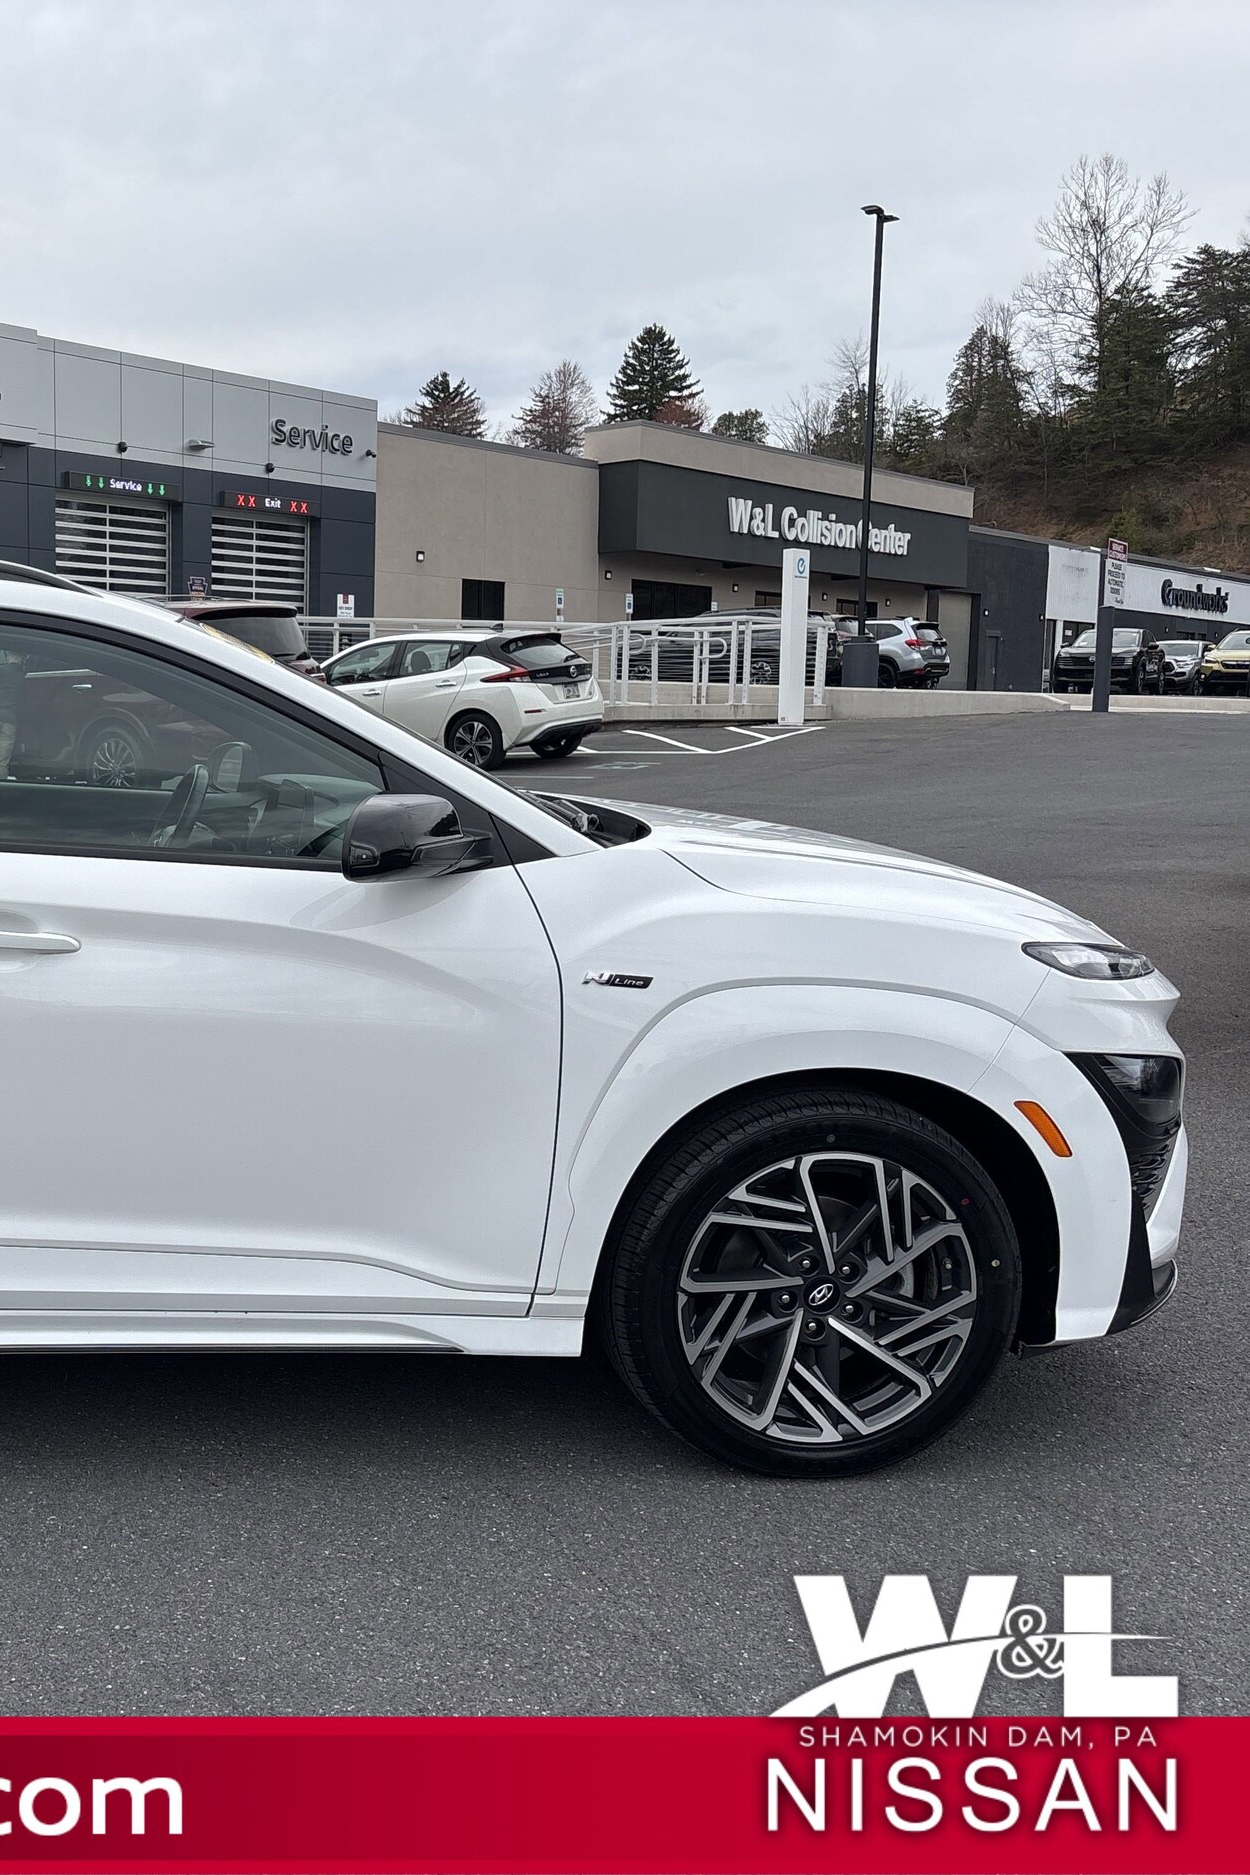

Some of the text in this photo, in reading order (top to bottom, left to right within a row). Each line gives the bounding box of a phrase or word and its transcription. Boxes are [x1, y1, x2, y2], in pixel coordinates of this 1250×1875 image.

[271, 418, 354, 456] Service
[109, 478, 142, 492] Service
[264, 497, 282, 509] Exit
[728, 496, 780, 539] W&L
[781, 506, 857, 549] Collision
[1161, 579, 1229, 614] Groundworks
[614, 977, 645, 987] Line
